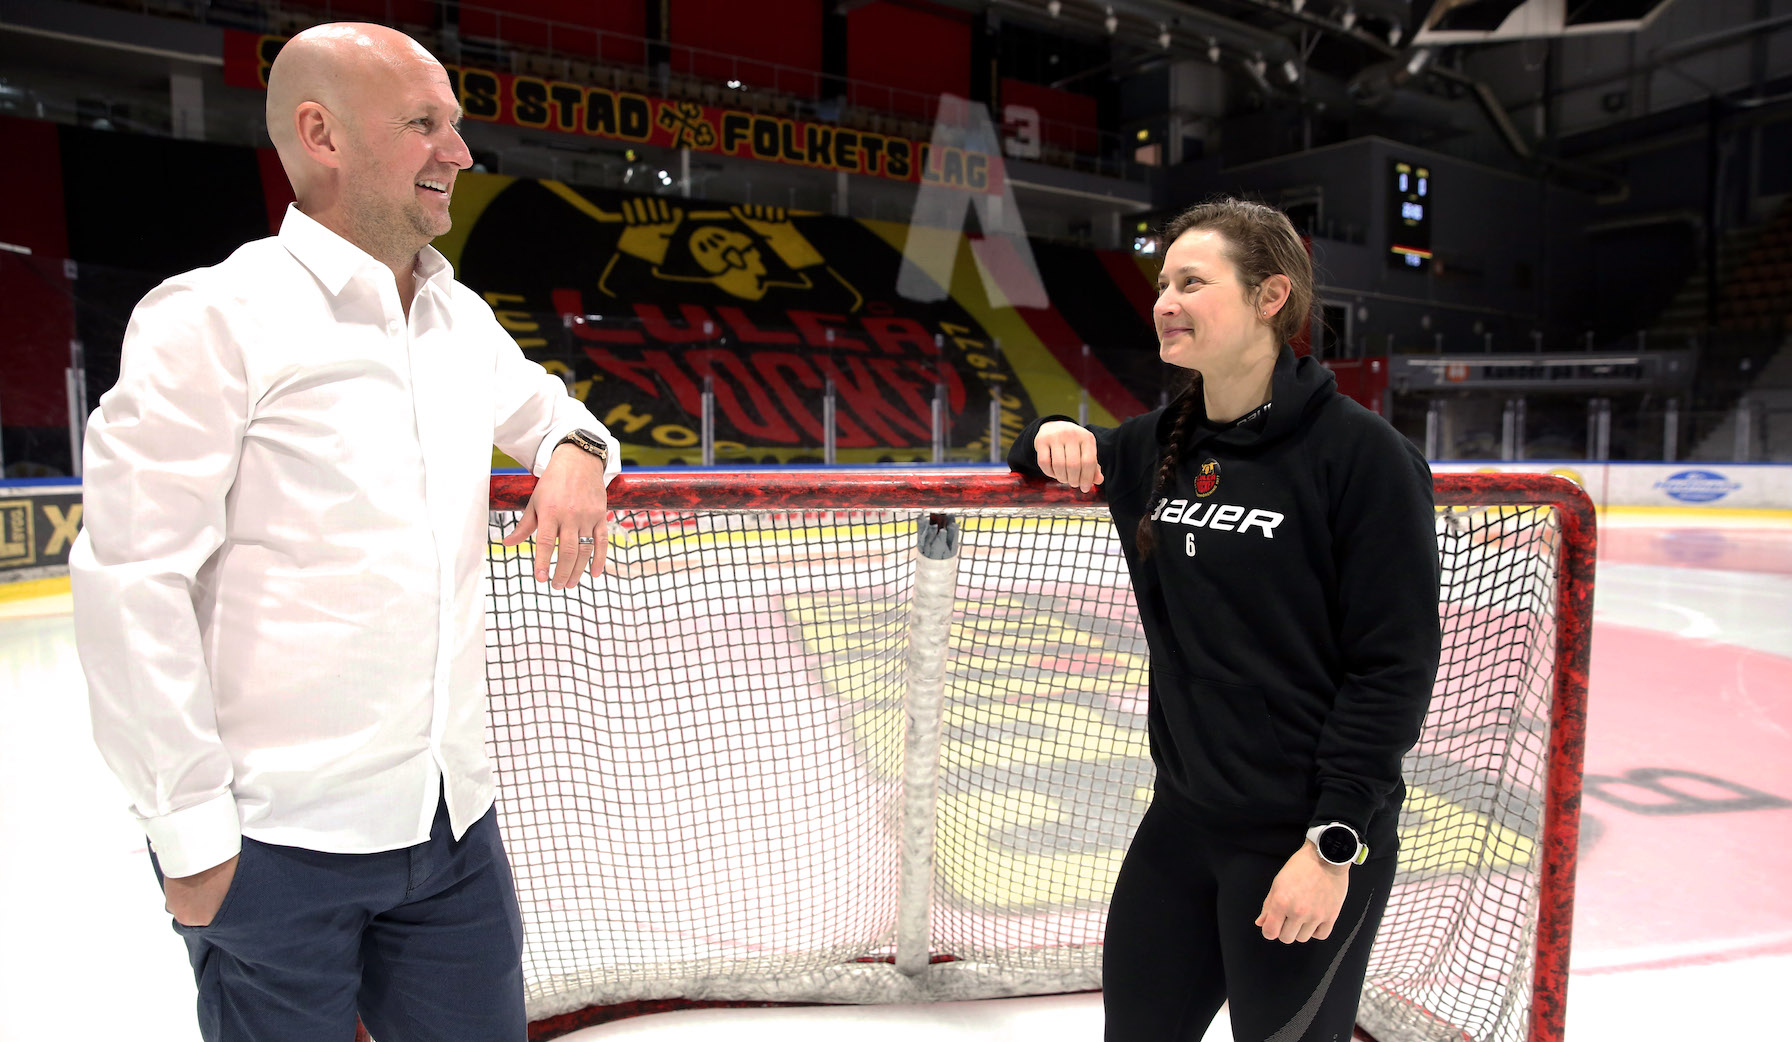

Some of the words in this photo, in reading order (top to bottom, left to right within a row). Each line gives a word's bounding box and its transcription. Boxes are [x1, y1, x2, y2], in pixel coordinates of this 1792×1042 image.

[513, 76, 652, 142] STAD
[721, 111, 911, 178] FOLKETS
[919, 143, 989, 193] LAG
[1004, 104, 1040, 158] 3
[551, 288, 945, 355] LULEÅ
[939, 321, 1008, 381] 1977
[585, 345, 966, 447] HOCKEY
[1185, 532, 1196, 557] 6
